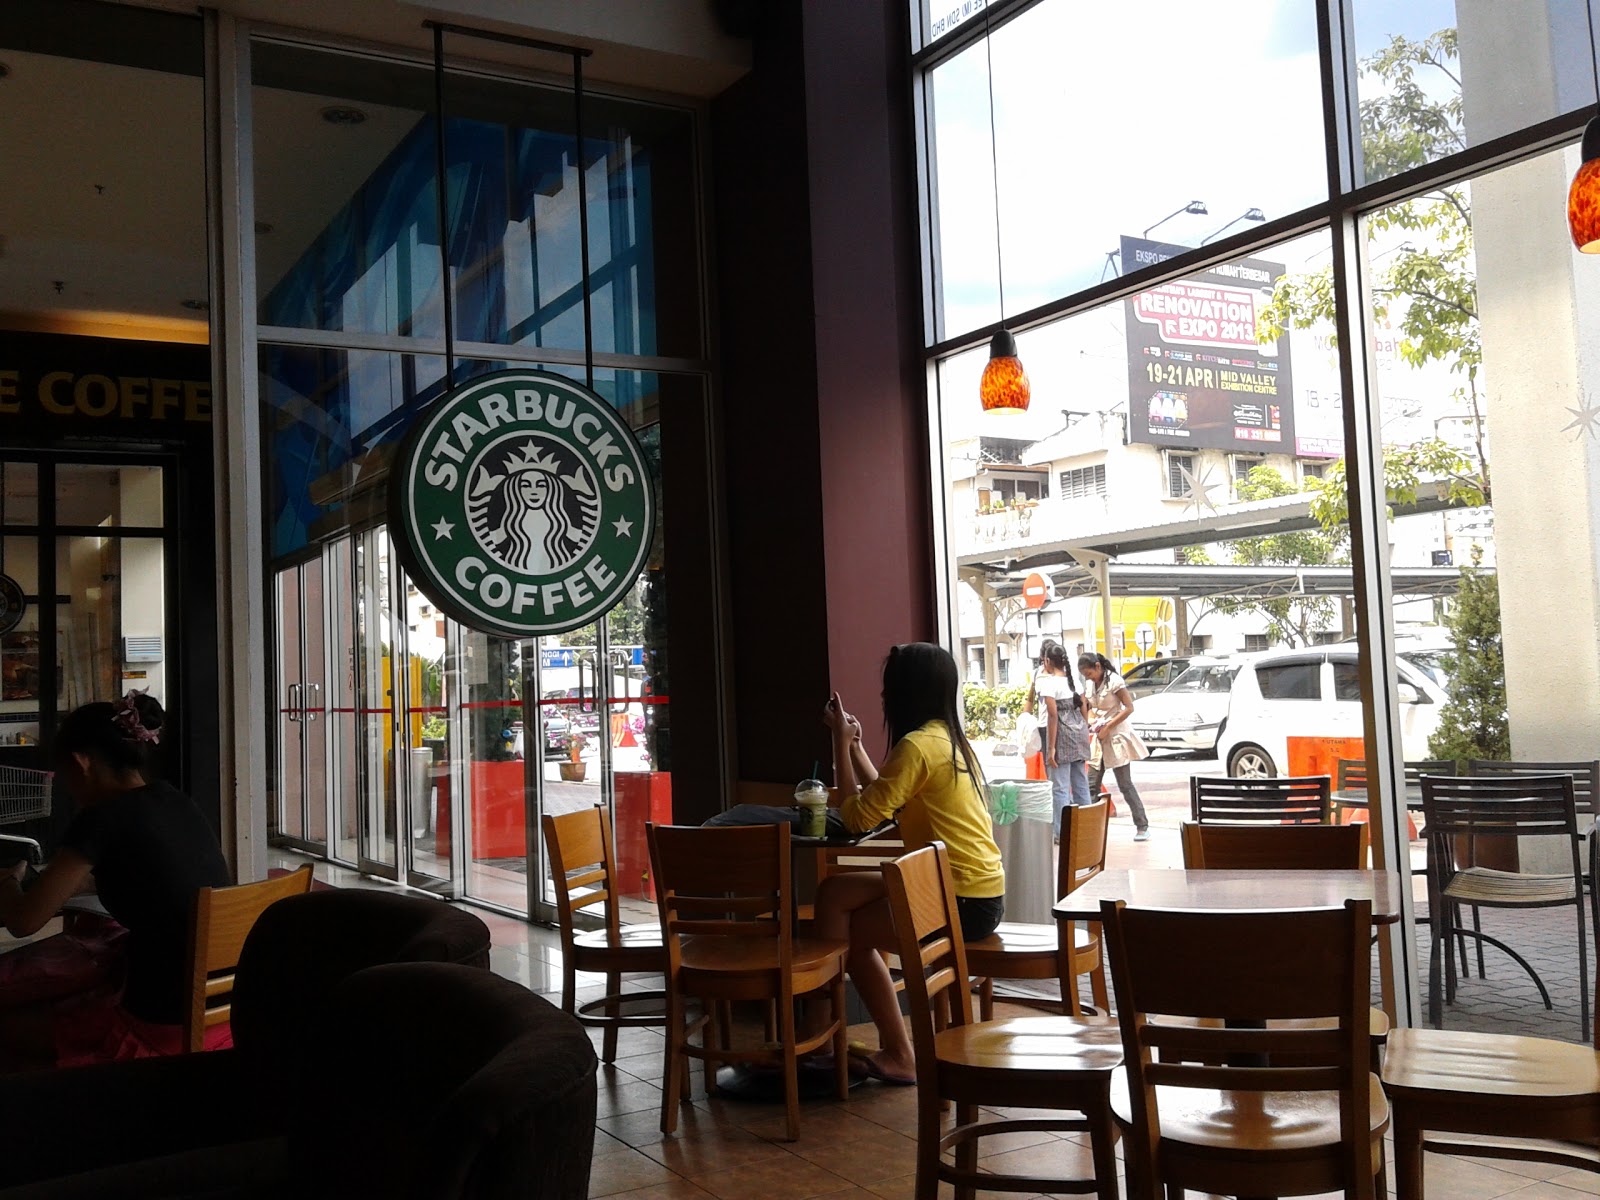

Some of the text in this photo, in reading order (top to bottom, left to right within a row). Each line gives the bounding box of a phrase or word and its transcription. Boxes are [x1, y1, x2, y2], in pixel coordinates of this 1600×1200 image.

[1140, 293, 1252, 322] RENOVATION
[1179, 317, 1254, 340] EXPO 2013
[1146, 362, 1214, 389] 19-21 APR
[1220, 370, 1276, 386] MID VALLEY
[1220, 382, 1277, 395] EXHIBITION CENTRE
[424, 389, 635, 492] STARBUCKS
[454, 554, 618, 616] COFFEE
